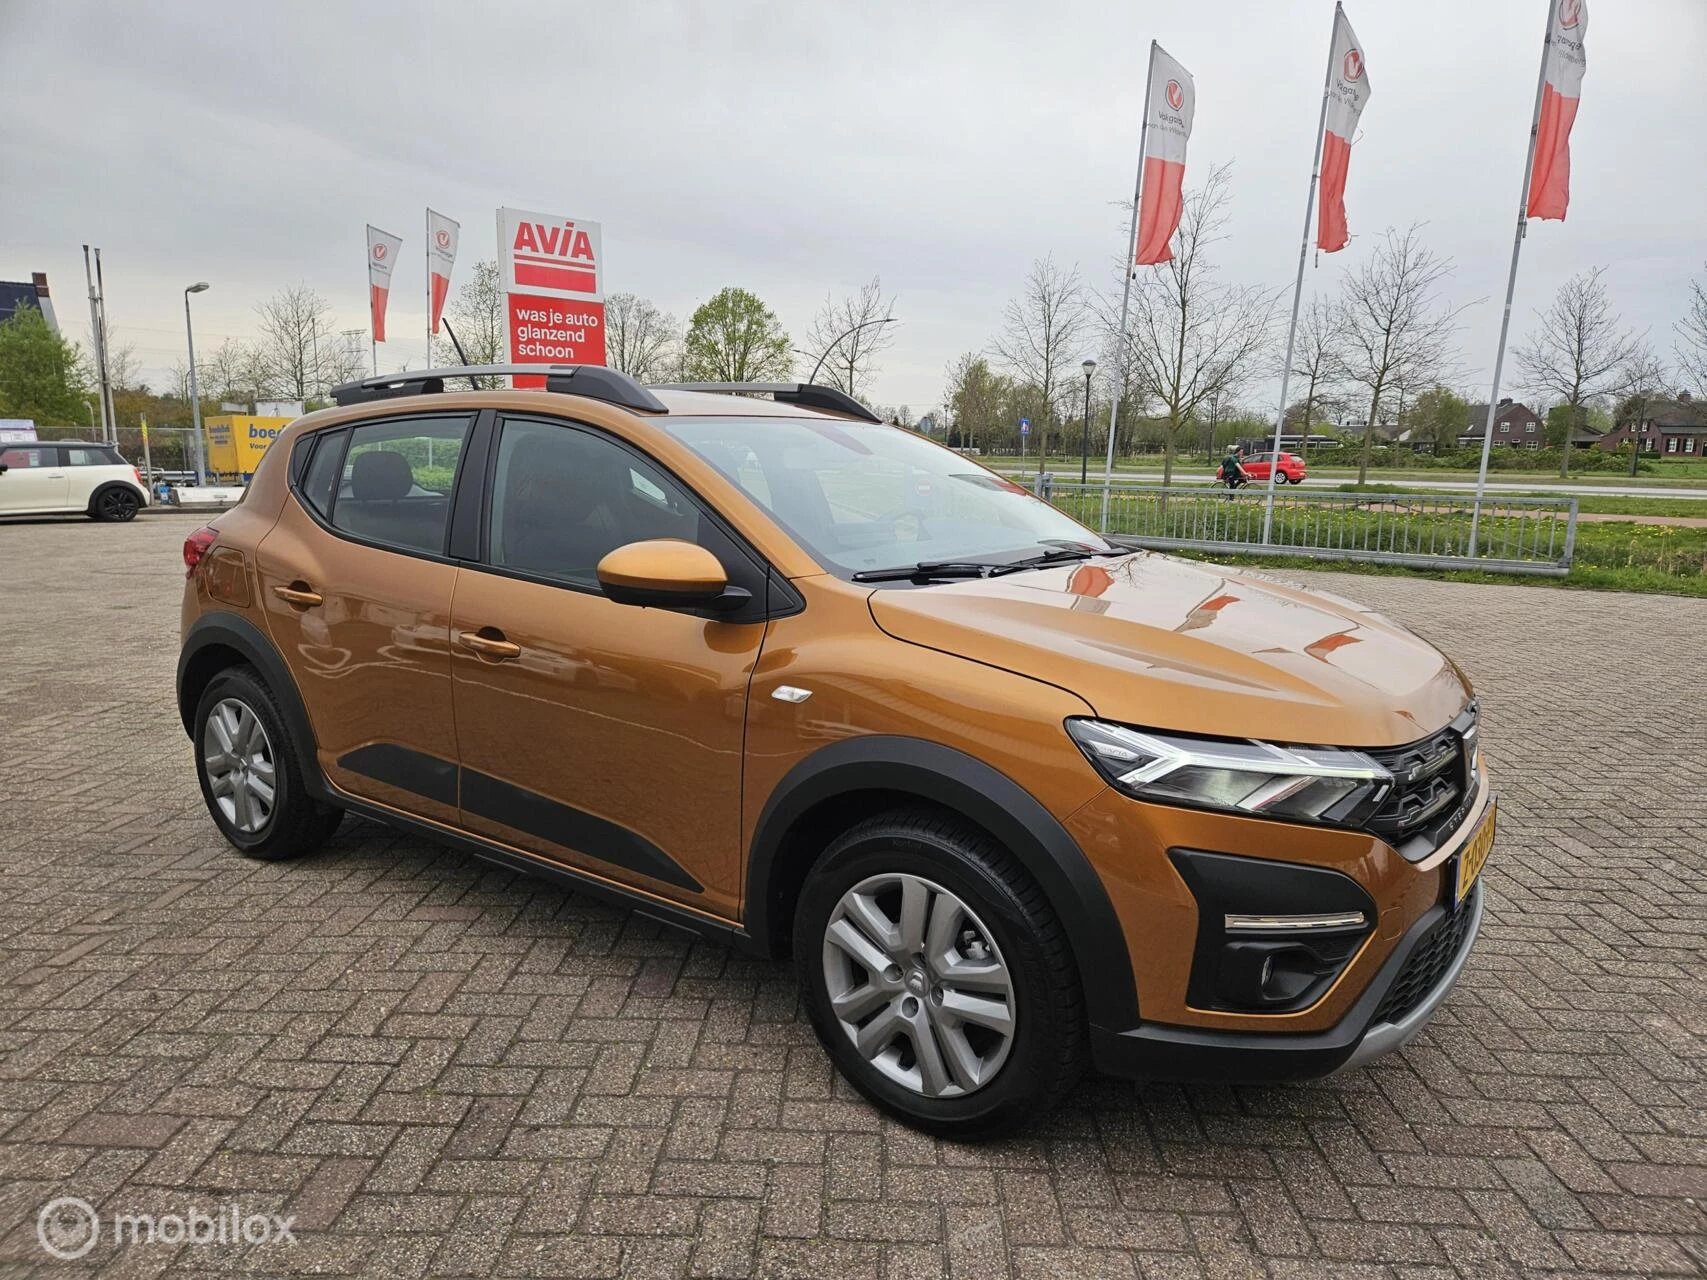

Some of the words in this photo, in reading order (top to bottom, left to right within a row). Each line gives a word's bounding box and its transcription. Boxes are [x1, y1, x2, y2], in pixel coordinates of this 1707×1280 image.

[516, 308, 546, 322] was
[548, 308, 563, 326] je
[565, 313, 599, 327] auto
[517, 324, 585, 343] glanzend
[518, 342, 574, 359] schoon
